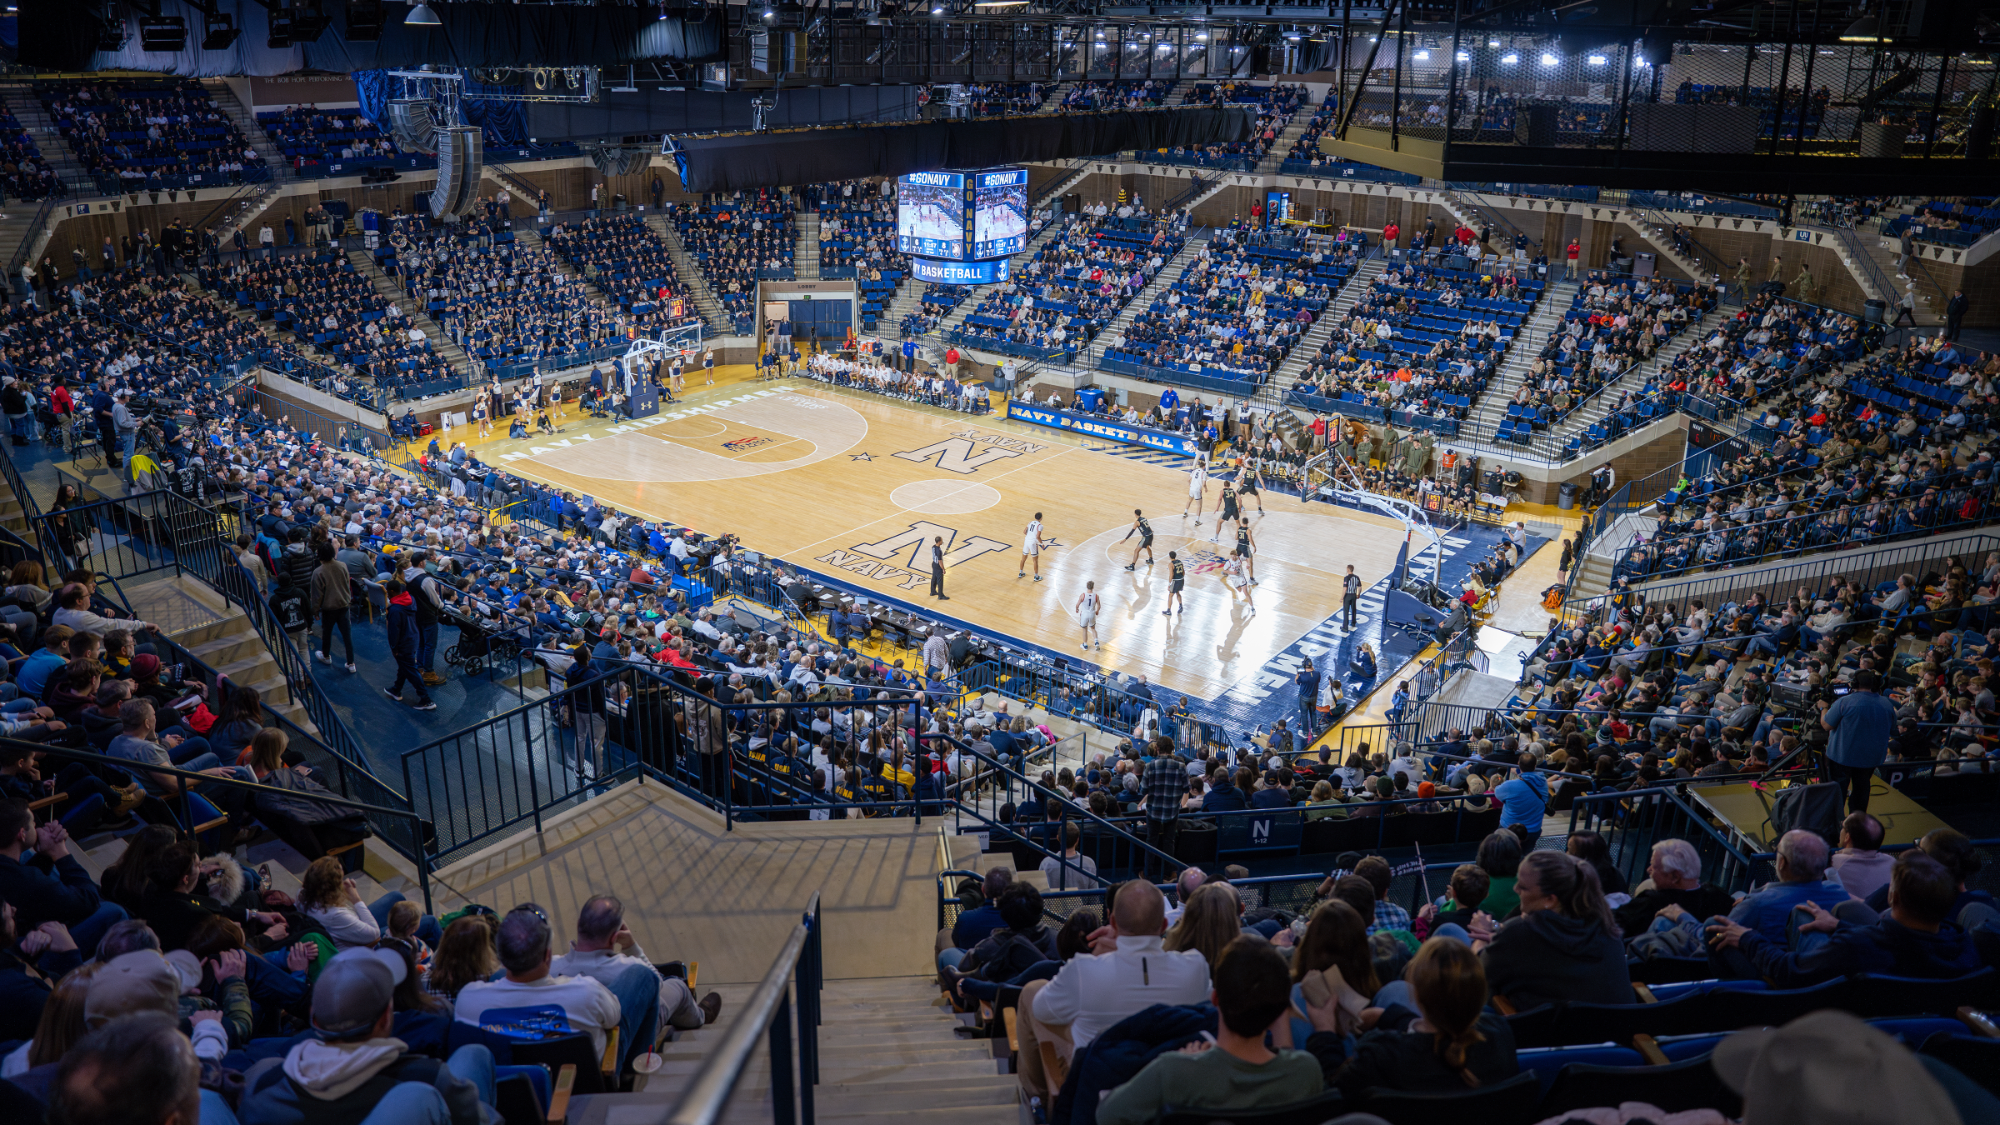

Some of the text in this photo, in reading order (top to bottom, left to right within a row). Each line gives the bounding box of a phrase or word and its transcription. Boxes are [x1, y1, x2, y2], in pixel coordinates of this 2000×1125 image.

[909, 172, 950, 186] #GONAVY
[985, 172, 1018, 186] #GONAVY
[965, 179, 974, 254] GO NAVY
[921, 265, 982, 279] BASKETBALL
[605, 385, 794, 435] MIDSHIPMEN
[950, 429, 1048, 454] NAVY
[1010, 406, 1174, 449] NAVY BASKETBALL
[499, 432, 594, 463] NAVY
[890, 437, 1024, 474] N
[849, 520, 1012, 575] N
[1238, 532, 1245, 540] 31
[814, 549, 931, 590] NAVY
[1175, 564, 1184, 574] 23
[1253, 819, 1270, 838] N
